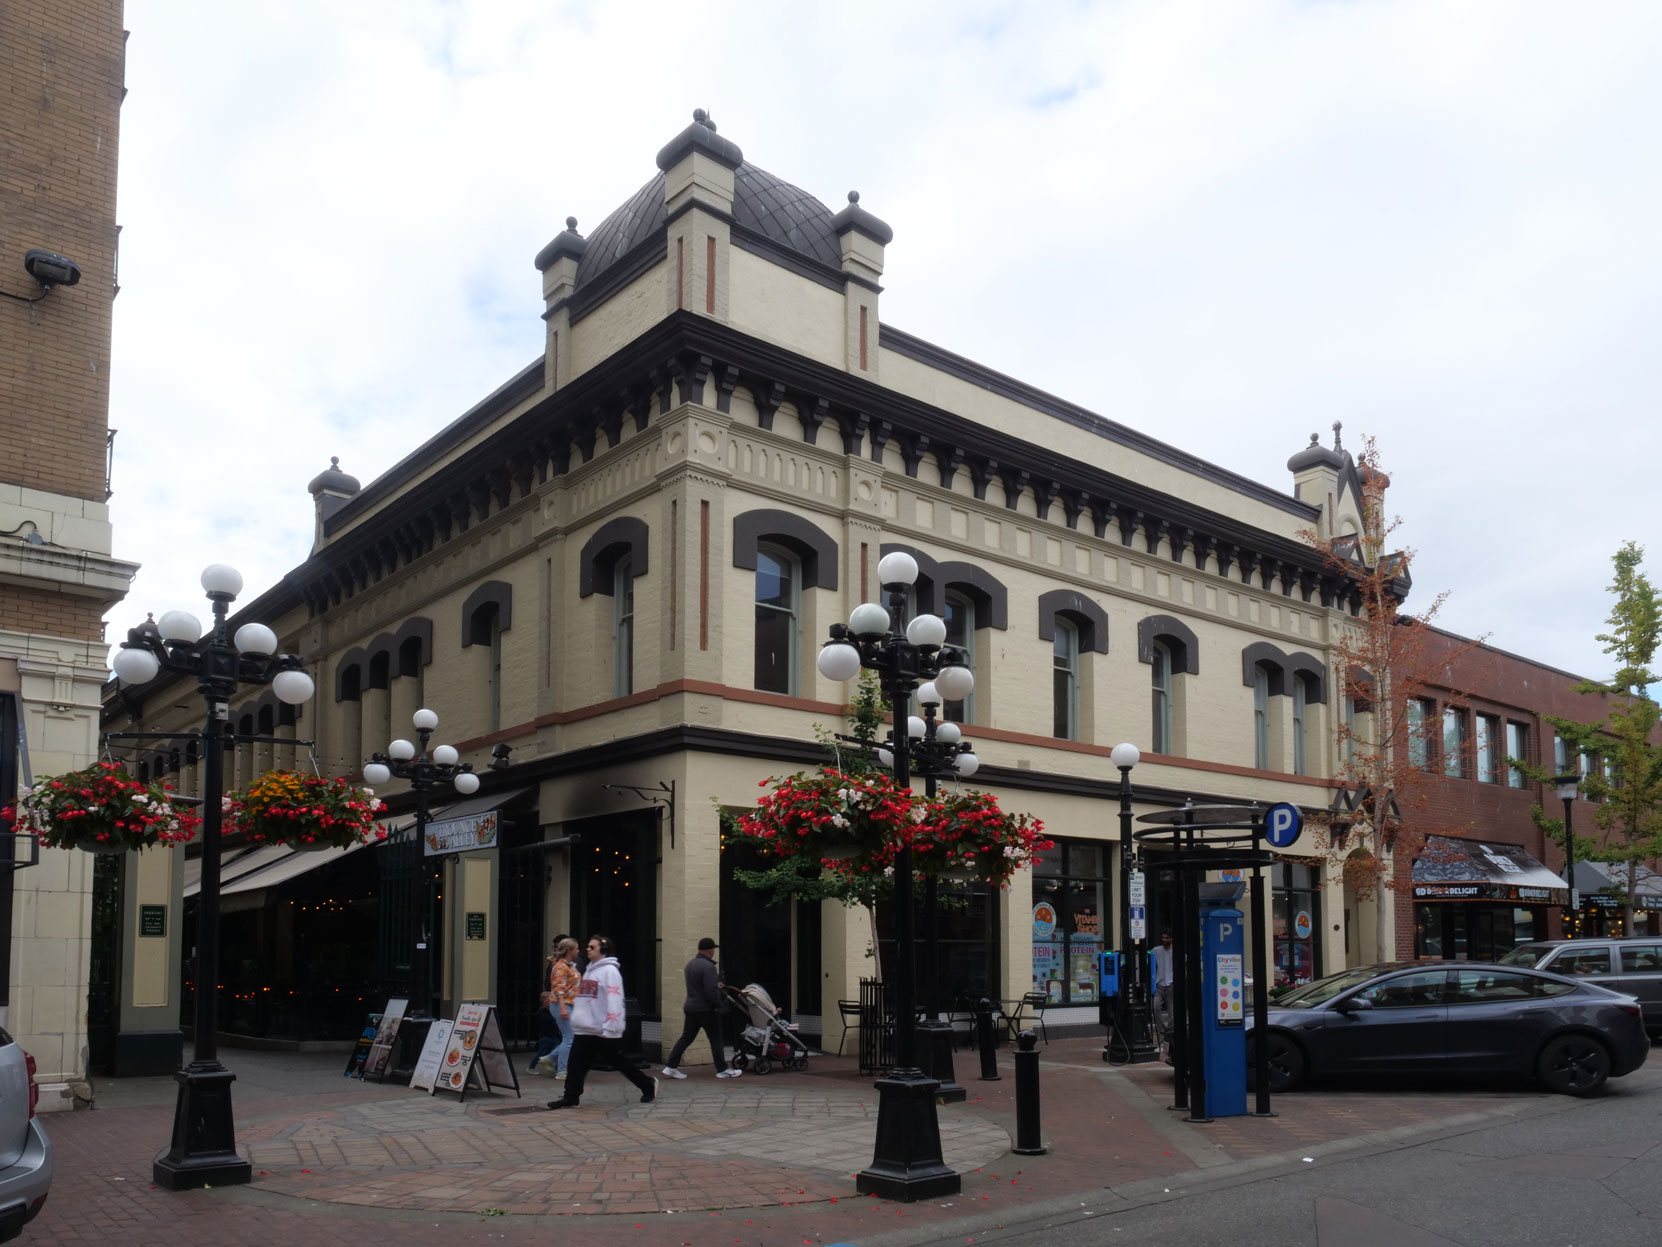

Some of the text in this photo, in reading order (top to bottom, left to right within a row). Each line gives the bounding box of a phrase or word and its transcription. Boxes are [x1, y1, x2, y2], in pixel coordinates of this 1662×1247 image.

[1273, 809, 1292, 842] P
[1449, 887, 1478, 895] DELIGHT
[1219, 923, 1232, 942] P
